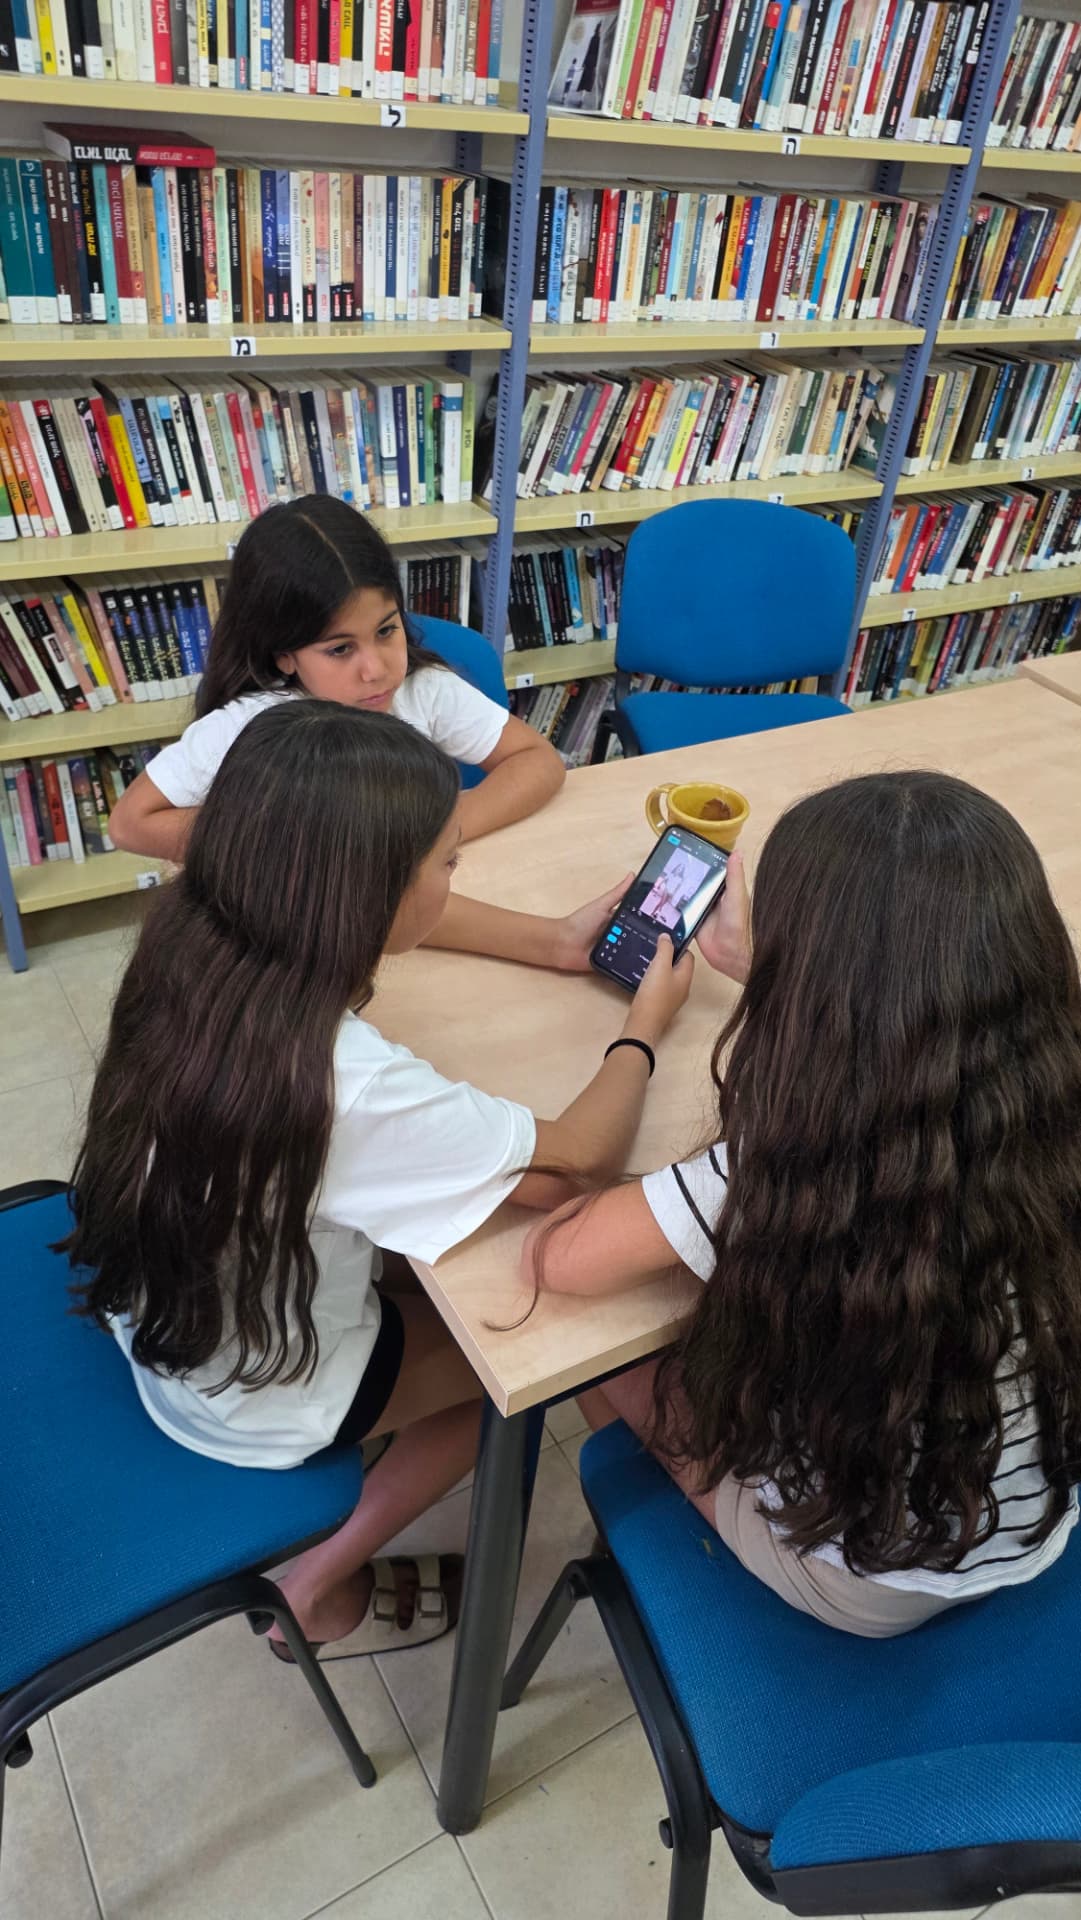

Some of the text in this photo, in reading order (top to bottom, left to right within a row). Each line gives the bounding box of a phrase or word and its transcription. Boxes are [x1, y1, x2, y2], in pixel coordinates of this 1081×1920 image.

[154, 3, 169, 34] האבן
[388, 104, 402, 127] ל
[73, 146, 132, 162] בראד מלצר
[786, 137, 797, 155] ה
[110, 179, 121, 199] סוכן
[452, 201, 462, 215] איל
[453, 216, 461, 232] מגד
[235, 338, 251, 356] מ
[464, 428, 472, 448] 1Q84
[580, 513, 591, 527] ח
